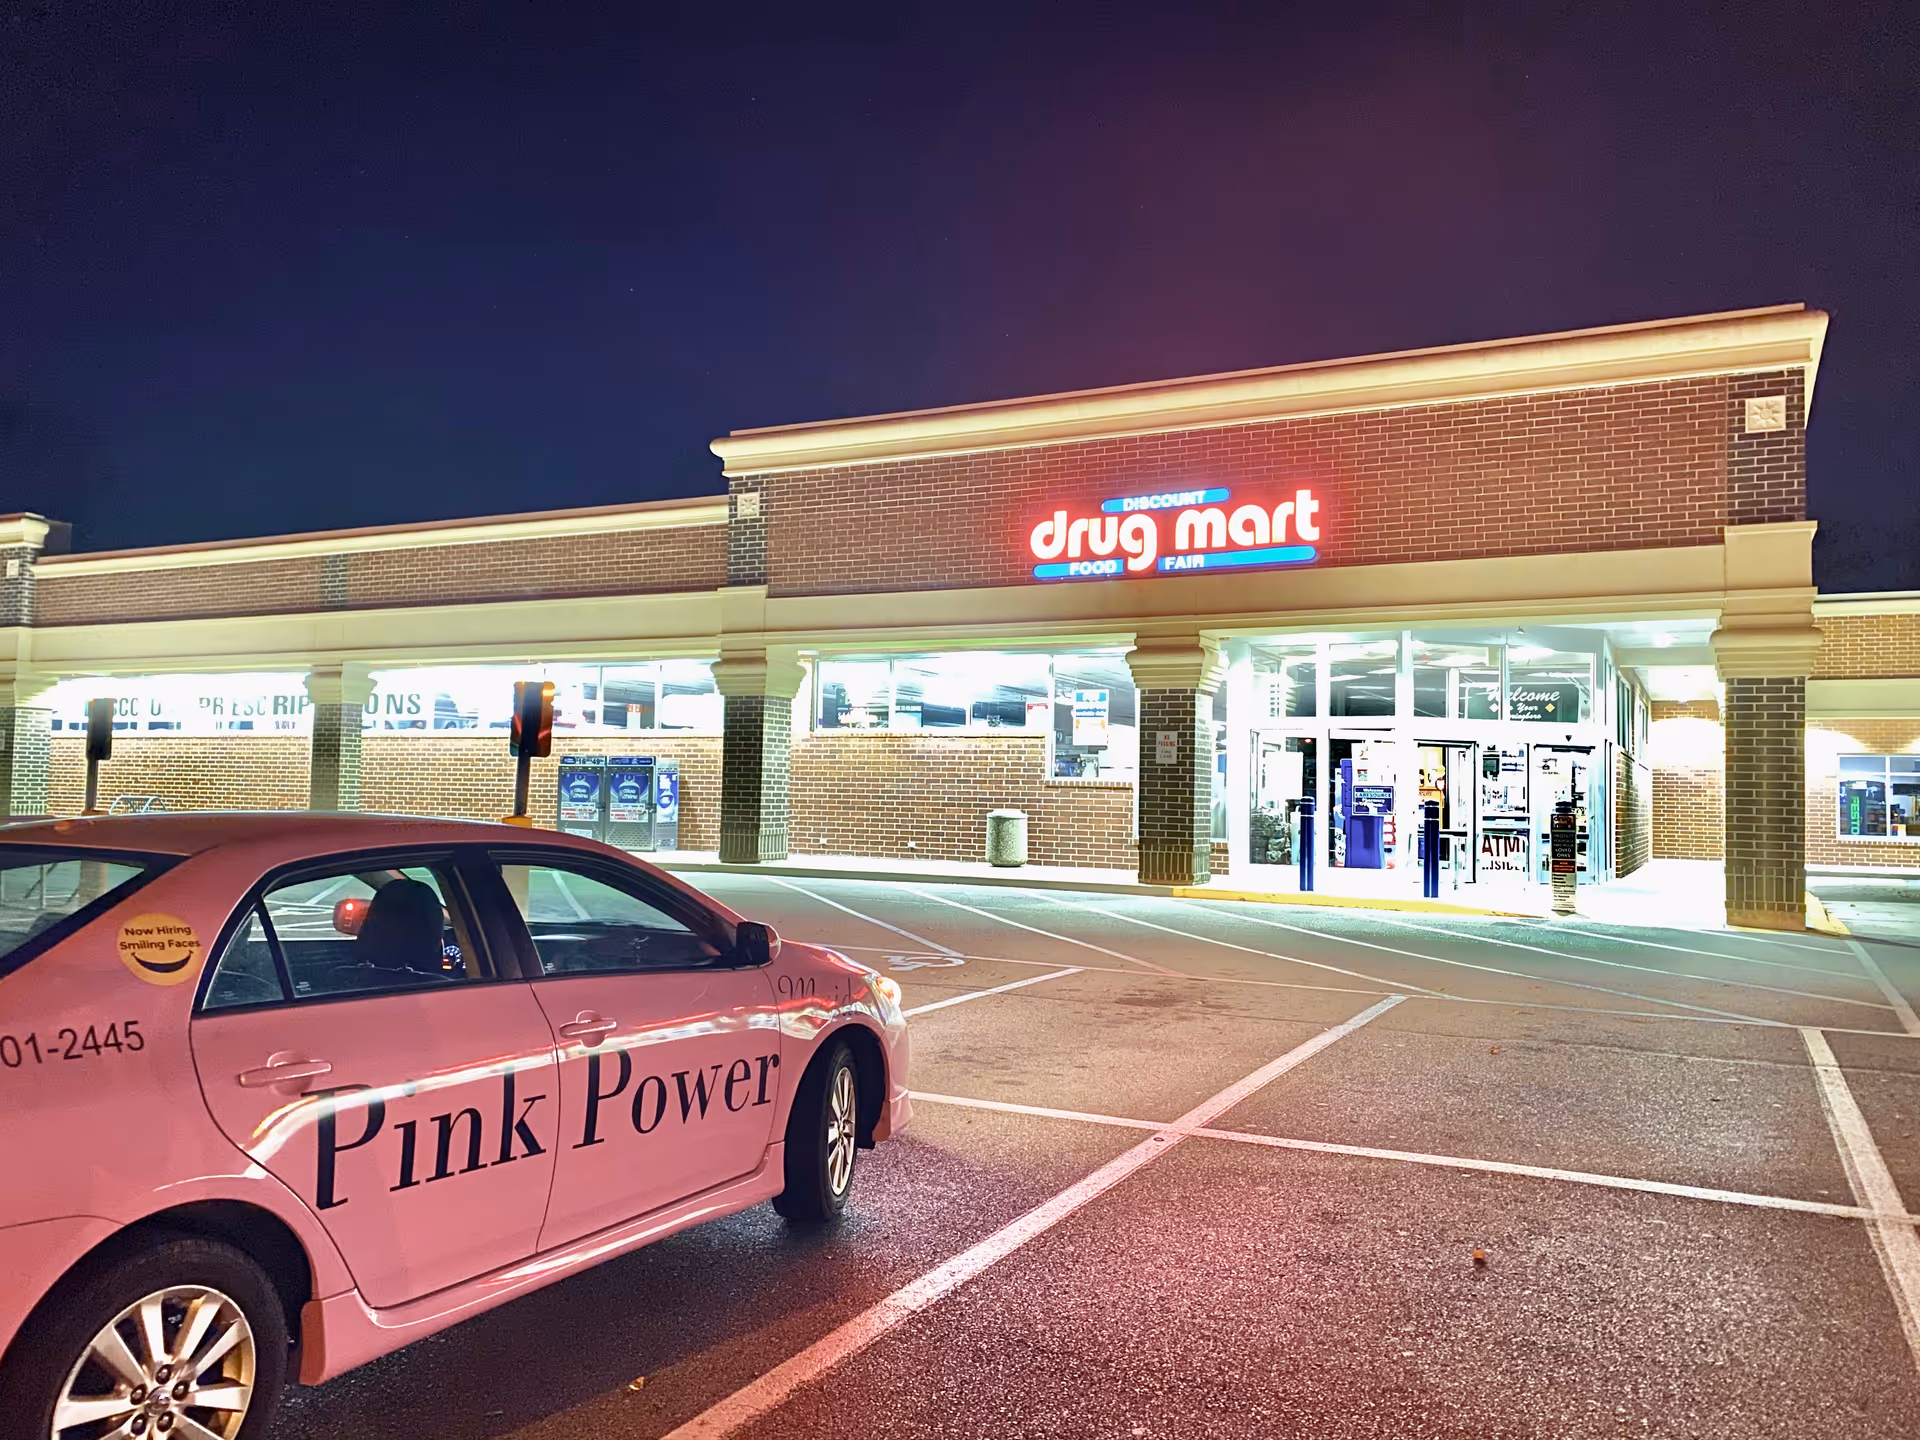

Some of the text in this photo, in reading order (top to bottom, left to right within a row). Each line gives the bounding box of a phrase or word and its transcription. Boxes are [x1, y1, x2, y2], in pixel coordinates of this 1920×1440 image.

[1123, 490, 1206, 512] DISCOUNT
[1030, 489, 1320, 571] drug mart
[1069, 555, 1205, 575] FOOD FAIR
[199, 693, 421, 716] PRESCRIPONS
[1482, 835, 1520, 857] ATM
[124, 925, 192, 936] Now Hiring
[119, 938, 201, 951] Smiling Faces
[0, 1020, 145, 1068] 01-2445
[301, 1048, 781, 1211] Pink Power
